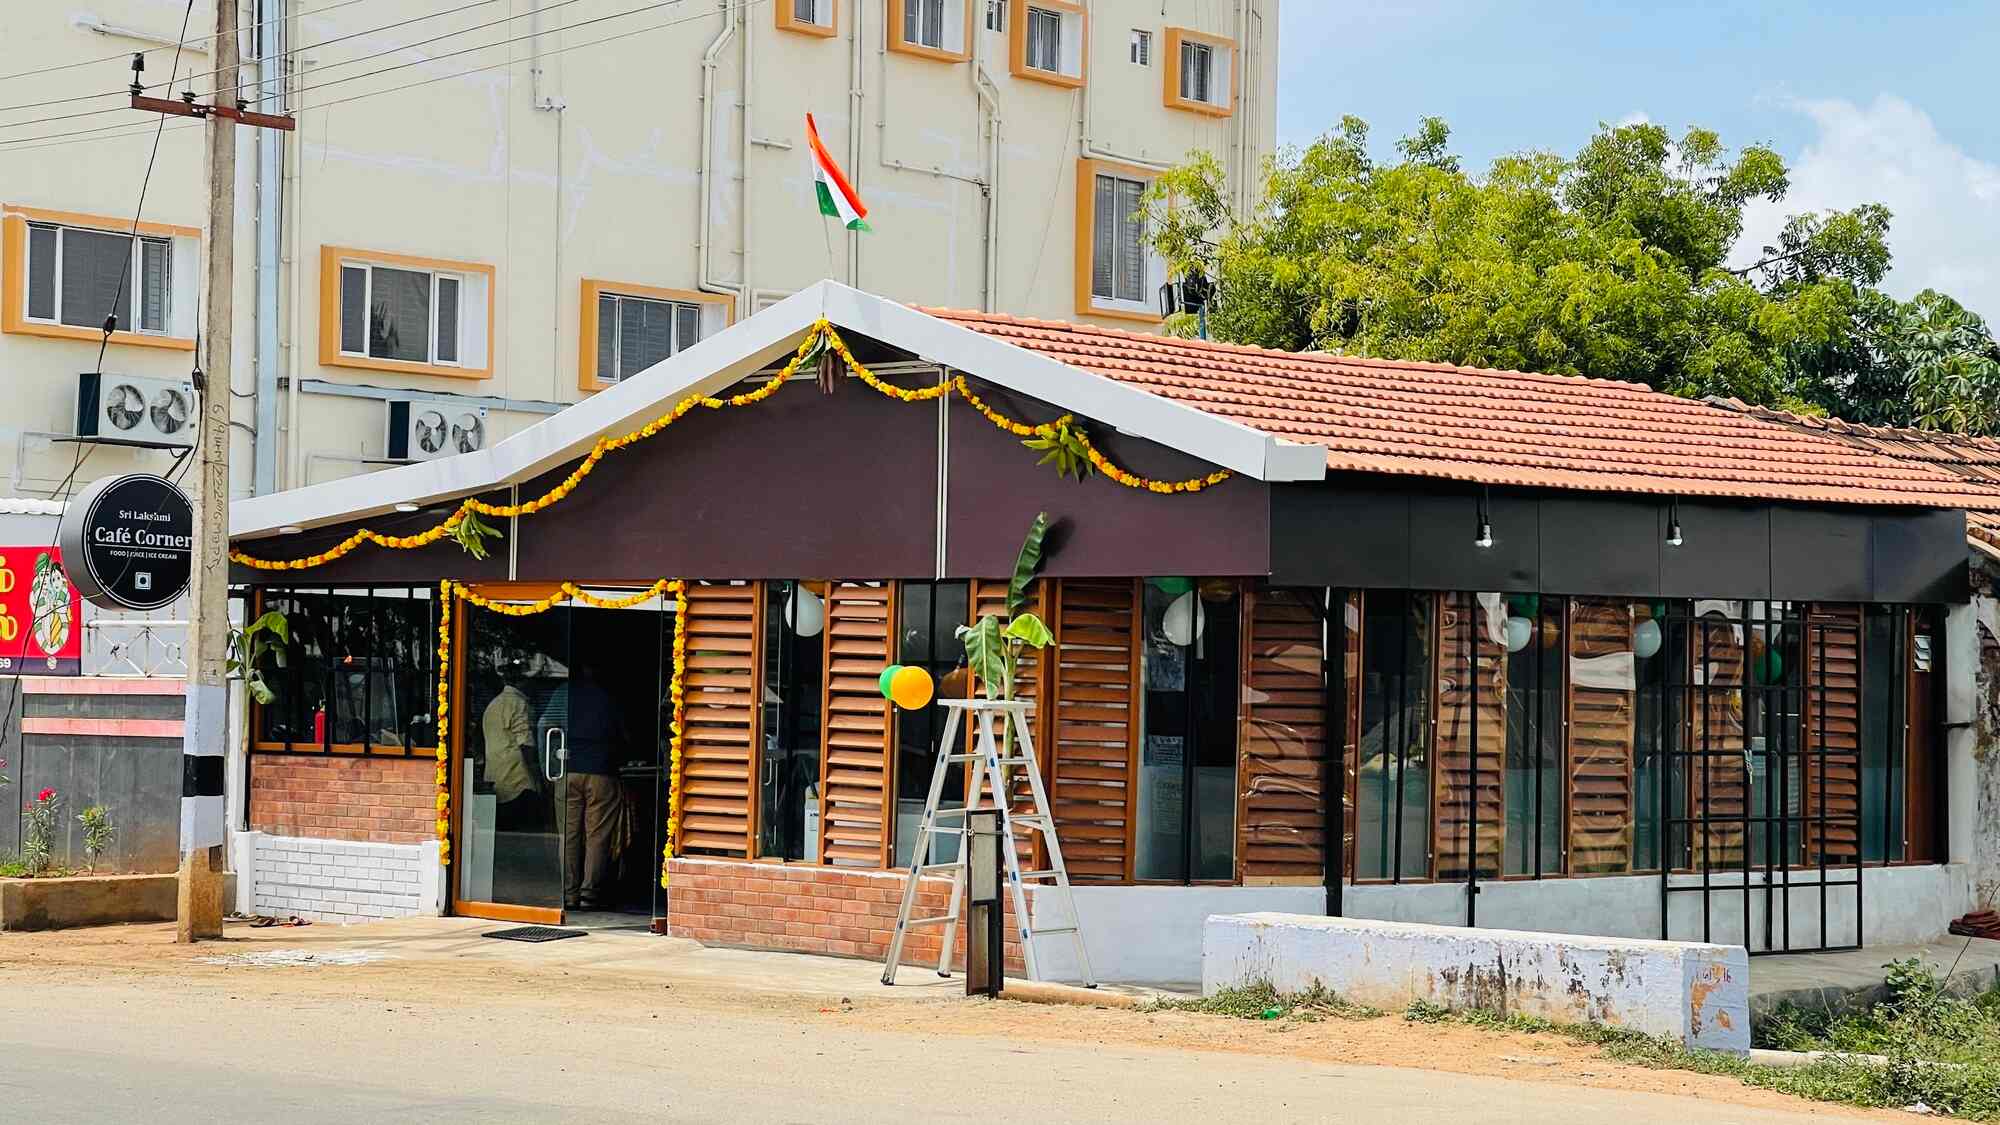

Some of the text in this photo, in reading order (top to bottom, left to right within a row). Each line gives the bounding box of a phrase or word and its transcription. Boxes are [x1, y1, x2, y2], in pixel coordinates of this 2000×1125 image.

[119, 510, 171, 521] Sri Lakshmi
[95, 526, 192, 547] Café Corner
[158, 552, 178, 560] CREAM
